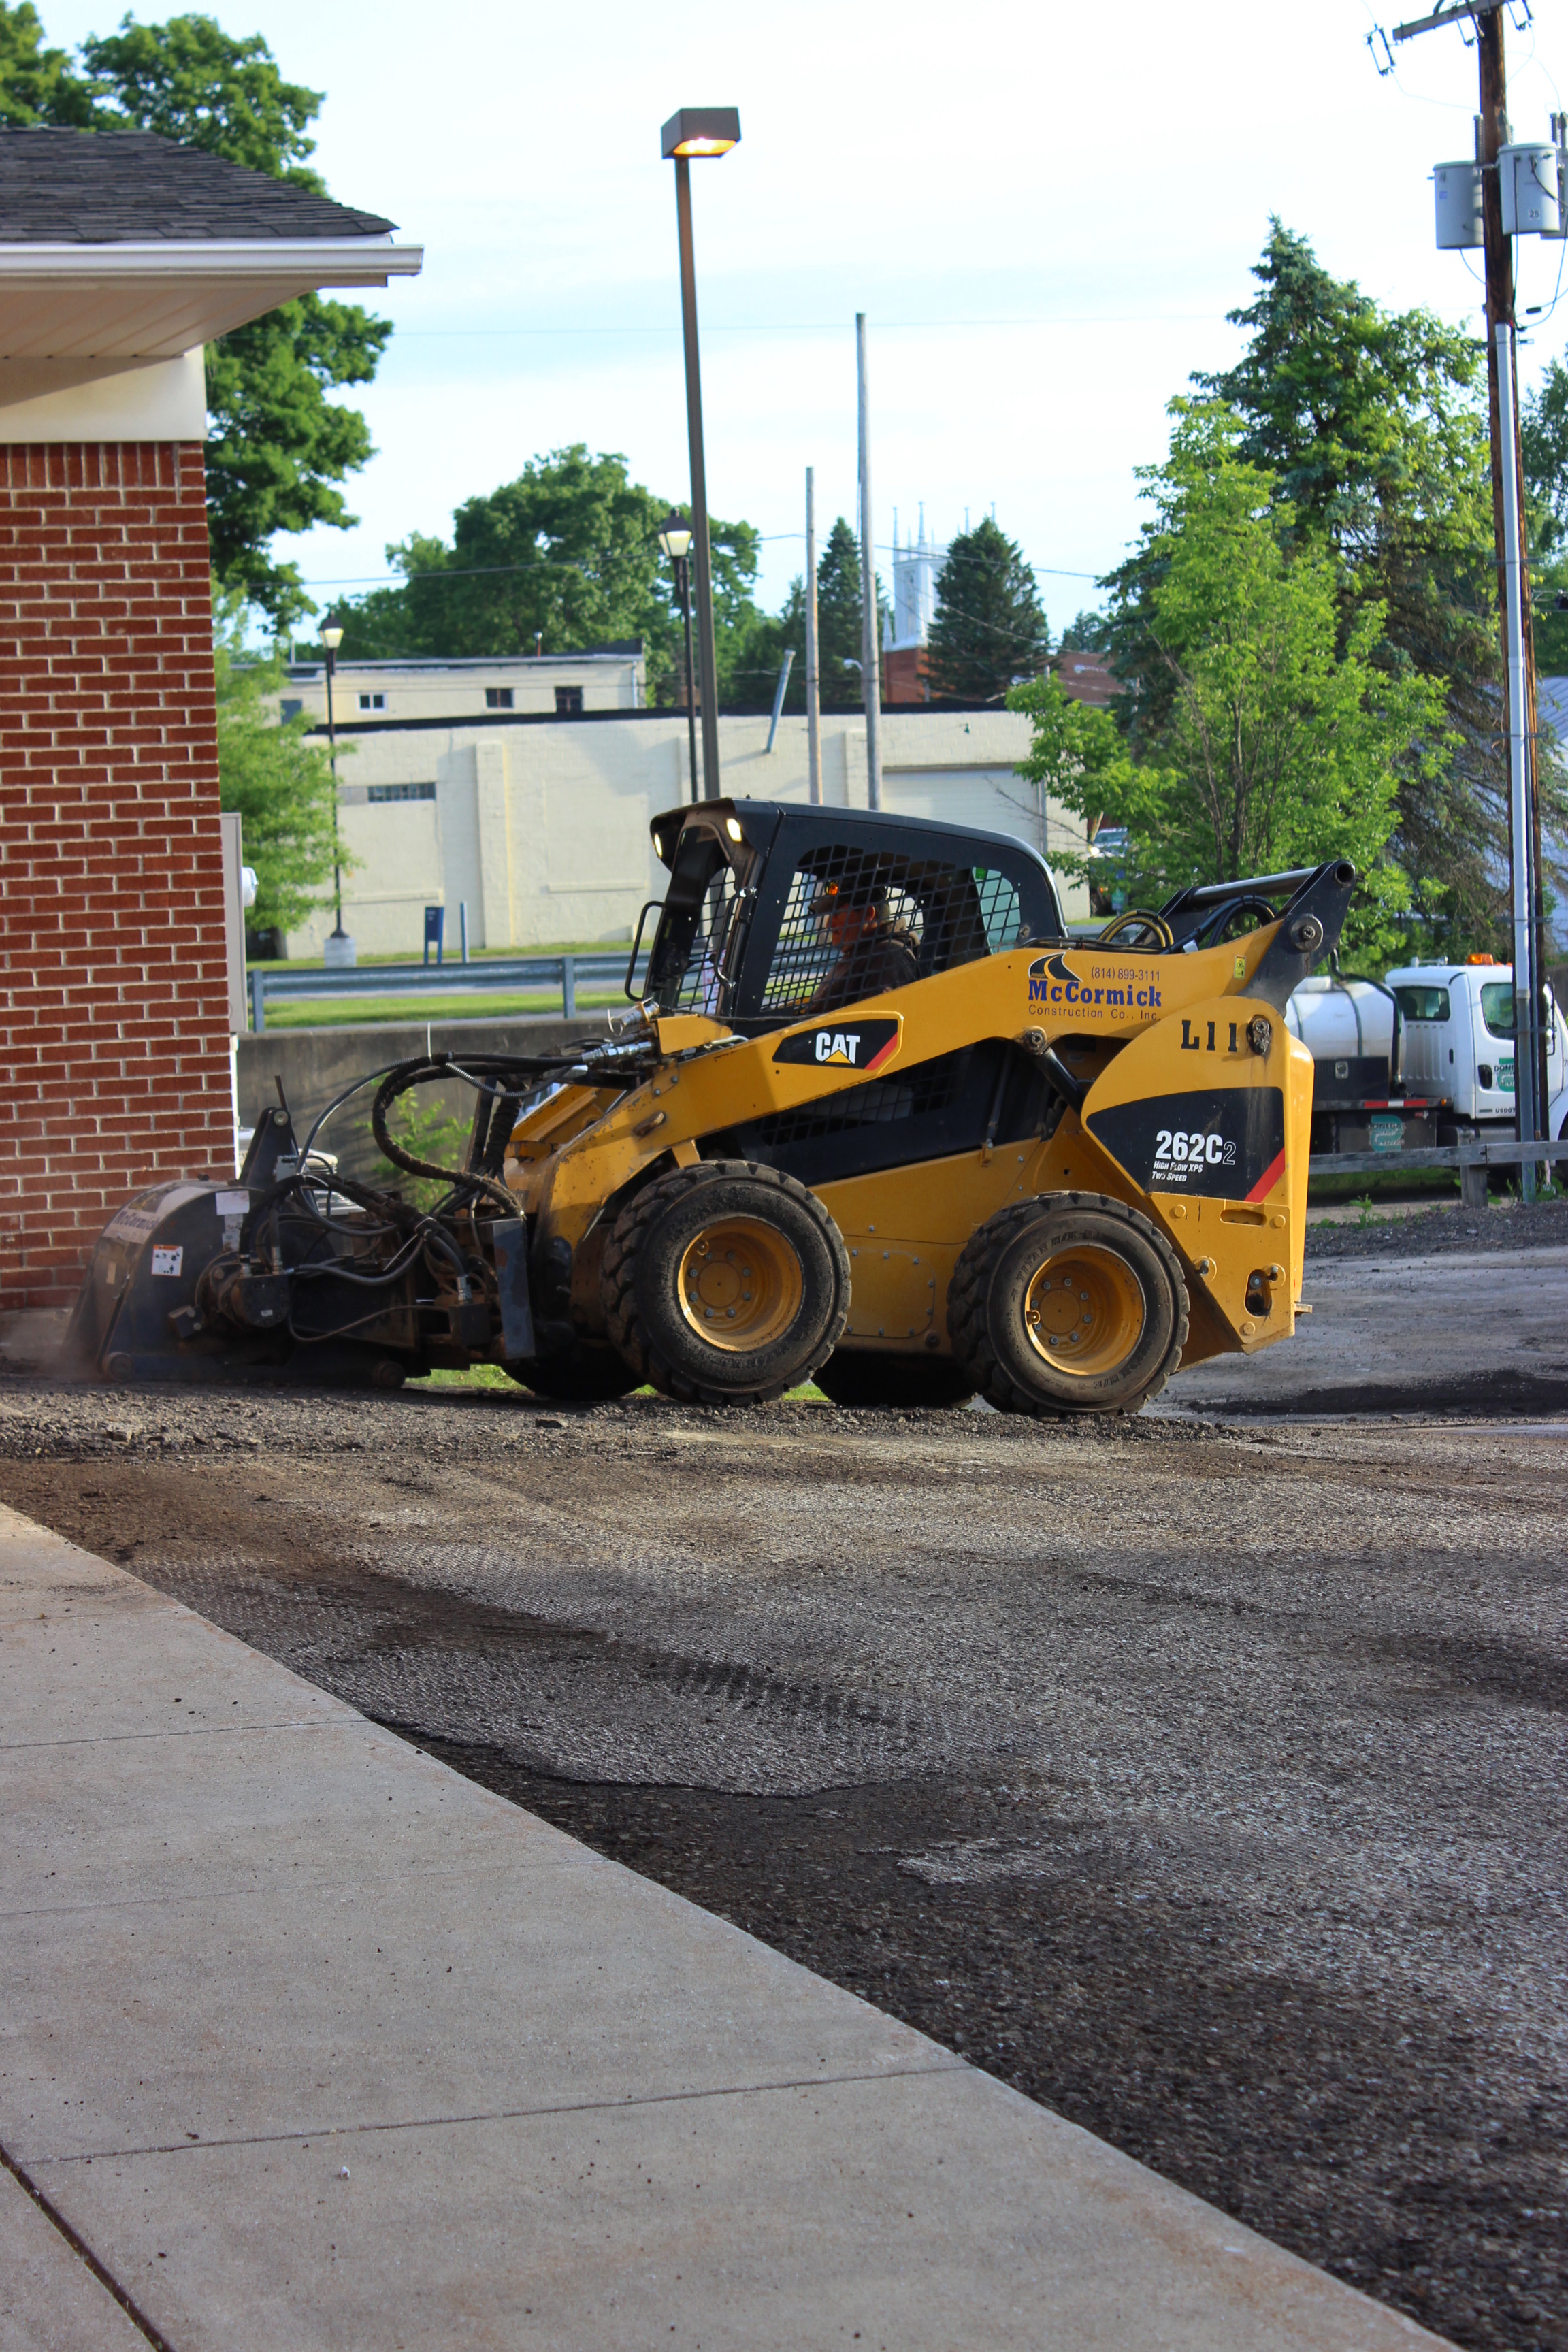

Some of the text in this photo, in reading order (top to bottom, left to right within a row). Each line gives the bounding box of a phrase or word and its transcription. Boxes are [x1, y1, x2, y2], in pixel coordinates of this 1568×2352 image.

[1091, 966, 1160, 981] (814) 899-3111
[1028, 979, 1161, 1007] McCormick
[1029, 1004, 1162, 1021] Construction Co., Inc.
[815, 1032, 860, 1064] CAT
[1188, 1163, 1204, 1173] XPS
